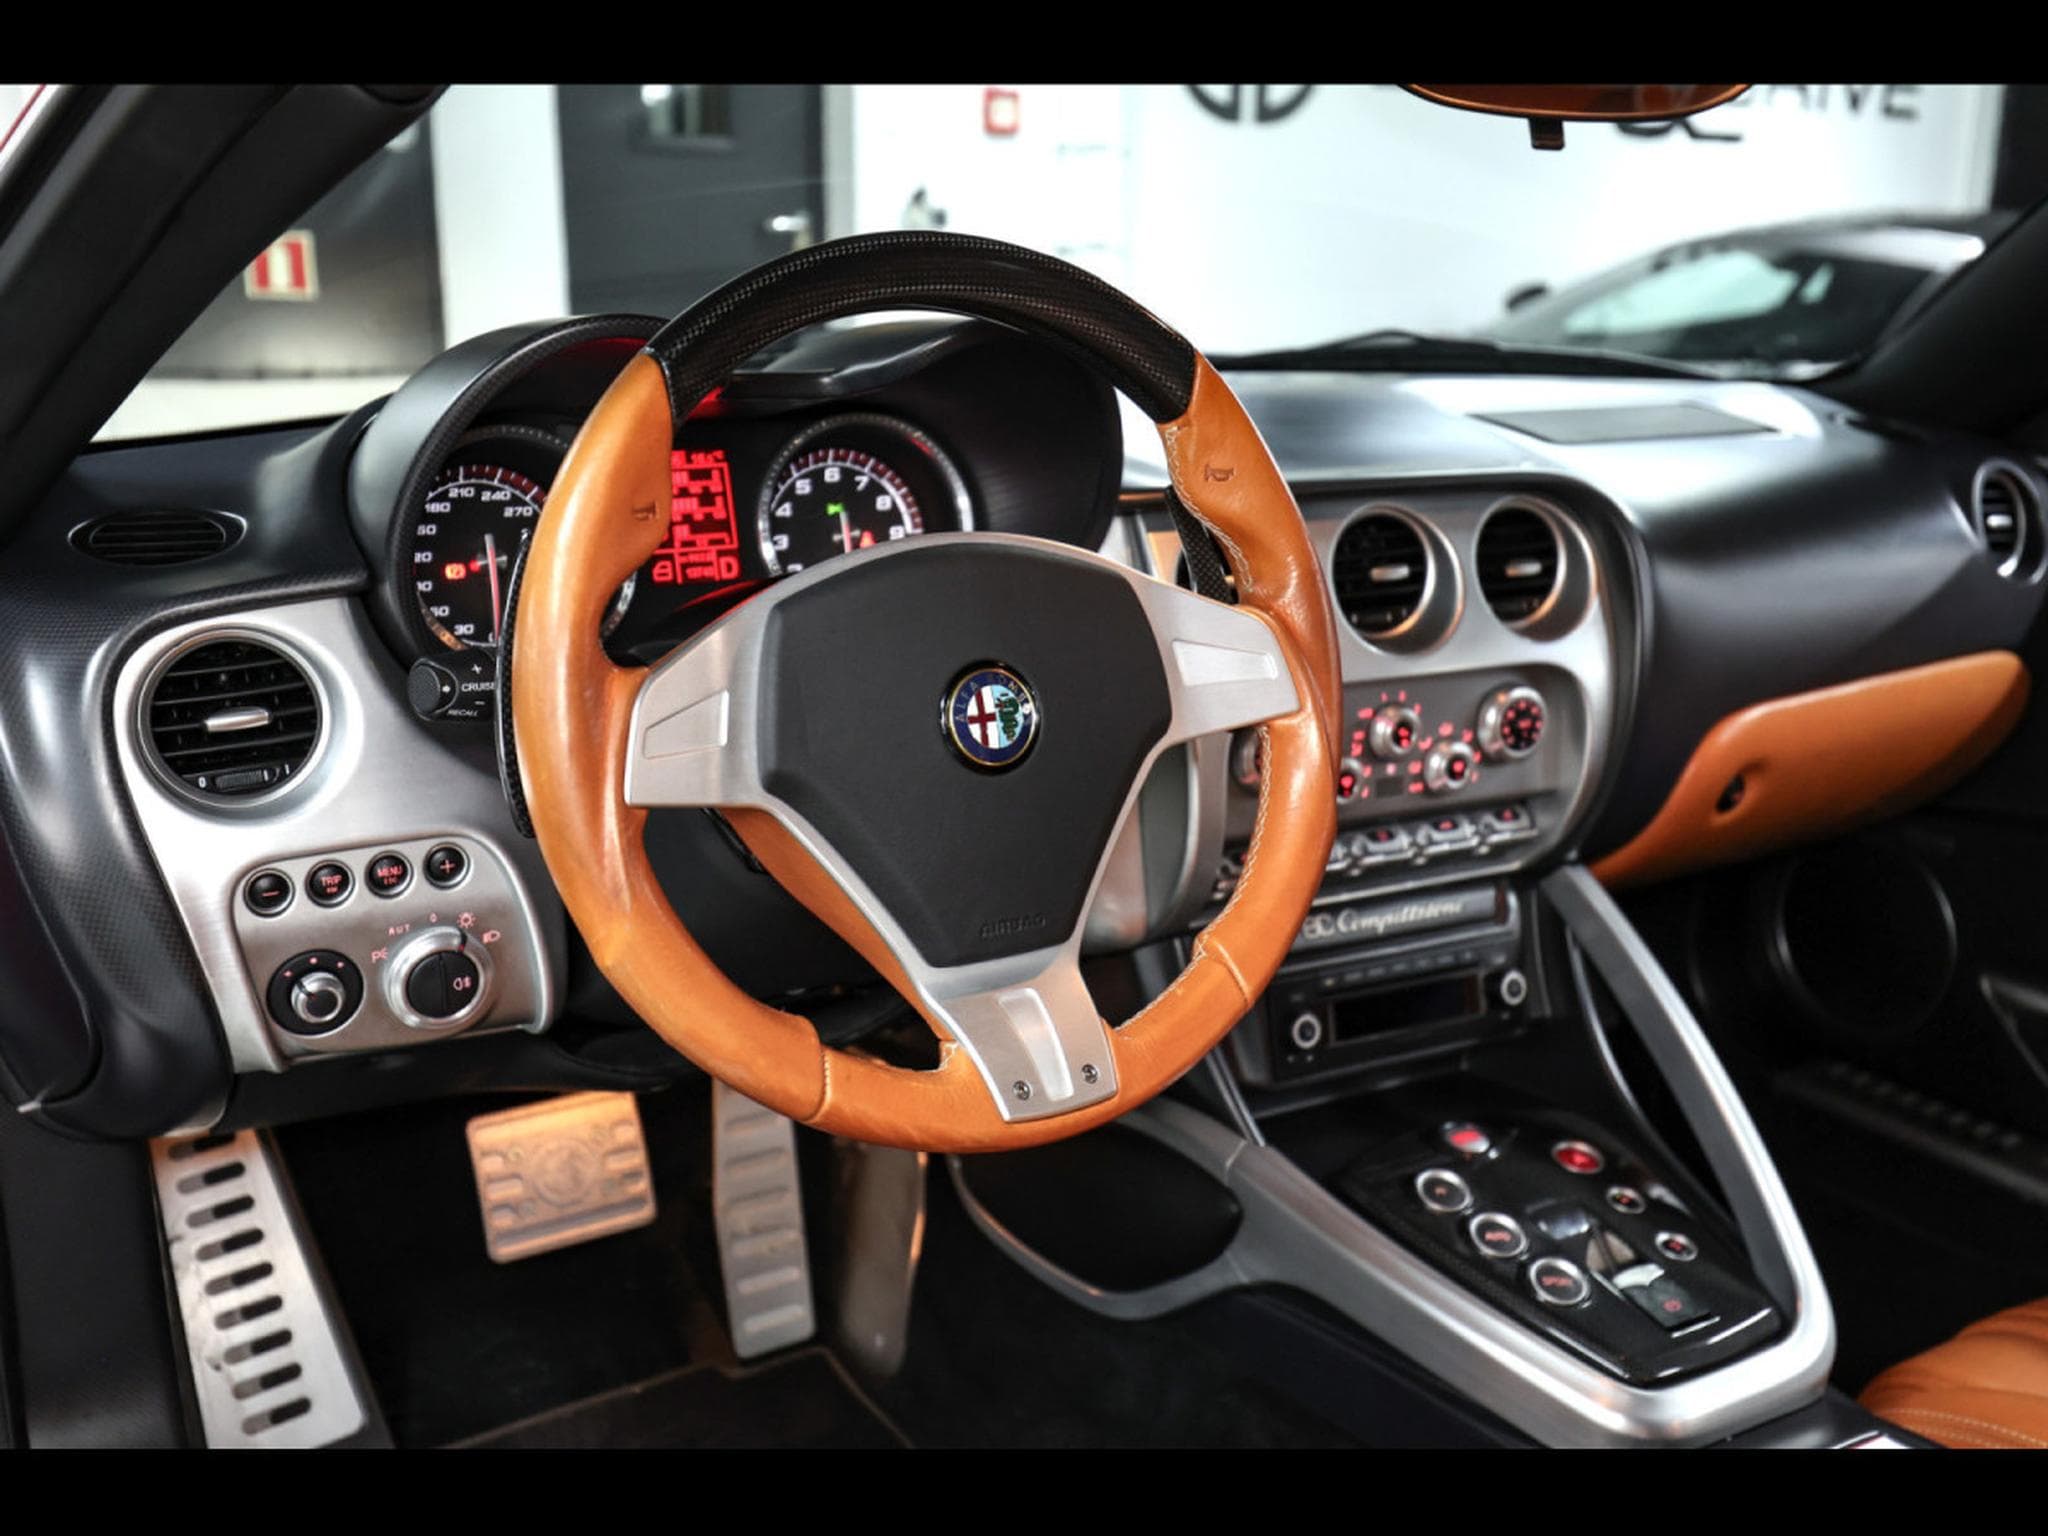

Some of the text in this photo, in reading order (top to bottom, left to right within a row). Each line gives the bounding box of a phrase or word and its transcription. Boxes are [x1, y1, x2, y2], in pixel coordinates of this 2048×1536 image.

[824, 467, 841, 483] 6
[795, 479, 812, 495] 5
[854, 475, 870, 491] 7
[448, 486, 475, 498] 210
[481, 491, 511, 502] 240
[425, 502, 451, 513] 180
[775, 502, 793, 518] 4
[875, 495, 892, 511] 8
[503, 506, 533, 517] 270
[889, 525, 905, 541] 9
[773, 534, 789, 550] 3
[454, 624, 475, 636] 30
[377, 865, 402, 878] MENU
[320, 874, 343, 887] TRIP
